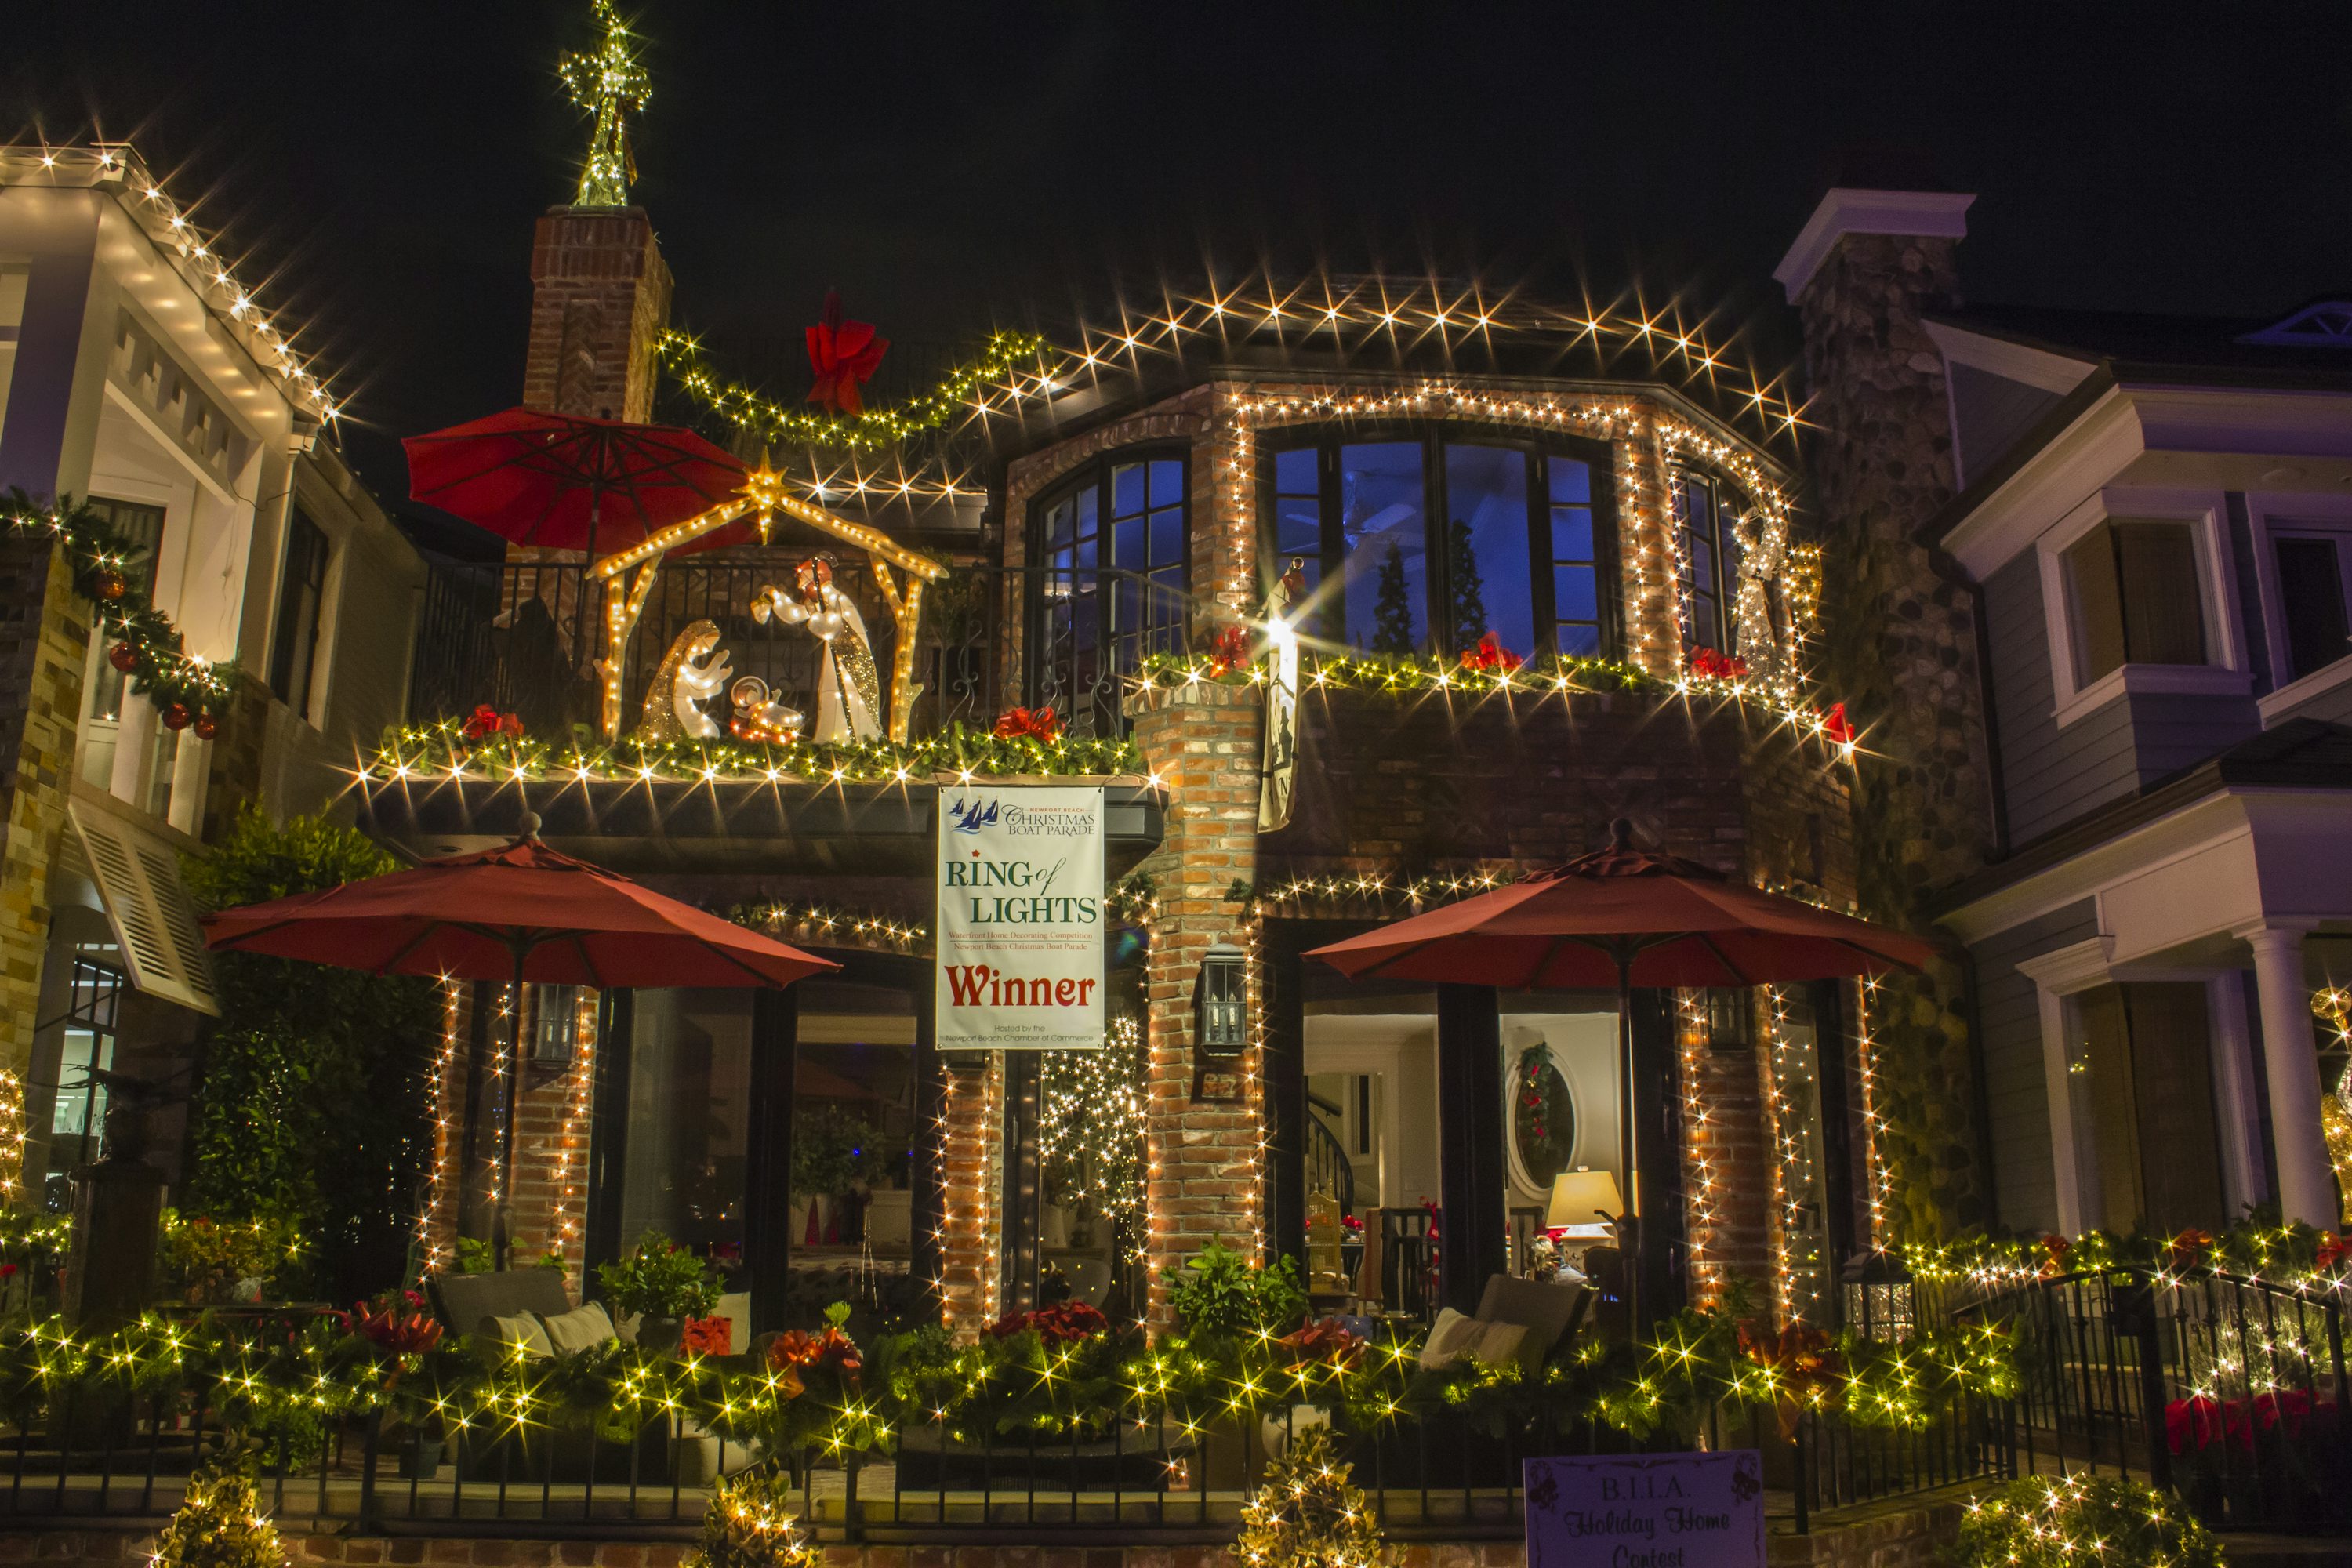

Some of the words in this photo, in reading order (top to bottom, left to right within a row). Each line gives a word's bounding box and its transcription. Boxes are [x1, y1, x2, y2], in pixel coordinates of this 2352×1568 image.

[1001, 804, 1095, 827] CHRISTMAS
[1008, 826, 1043, 836] BOAT
[1047, 826, 1095, 837] PARADE
[945, 861, 1033, 887] RING
[1036, 857, 1067, 896] of
[970, 897, 1098, 924] LIGHTS
[1010, 931, 1048, 940] Decorating
[1050, 931, 1093, 940] Competition
[944, 964, 1096, 1007] Winner
[946, 1034, 976, 1043] Newport
[1564, 1509, 1656, 1540] Holiday
[1664, 1507, 1730, 1534] Home
[1612, 1544, 1685, 1568] Contest
